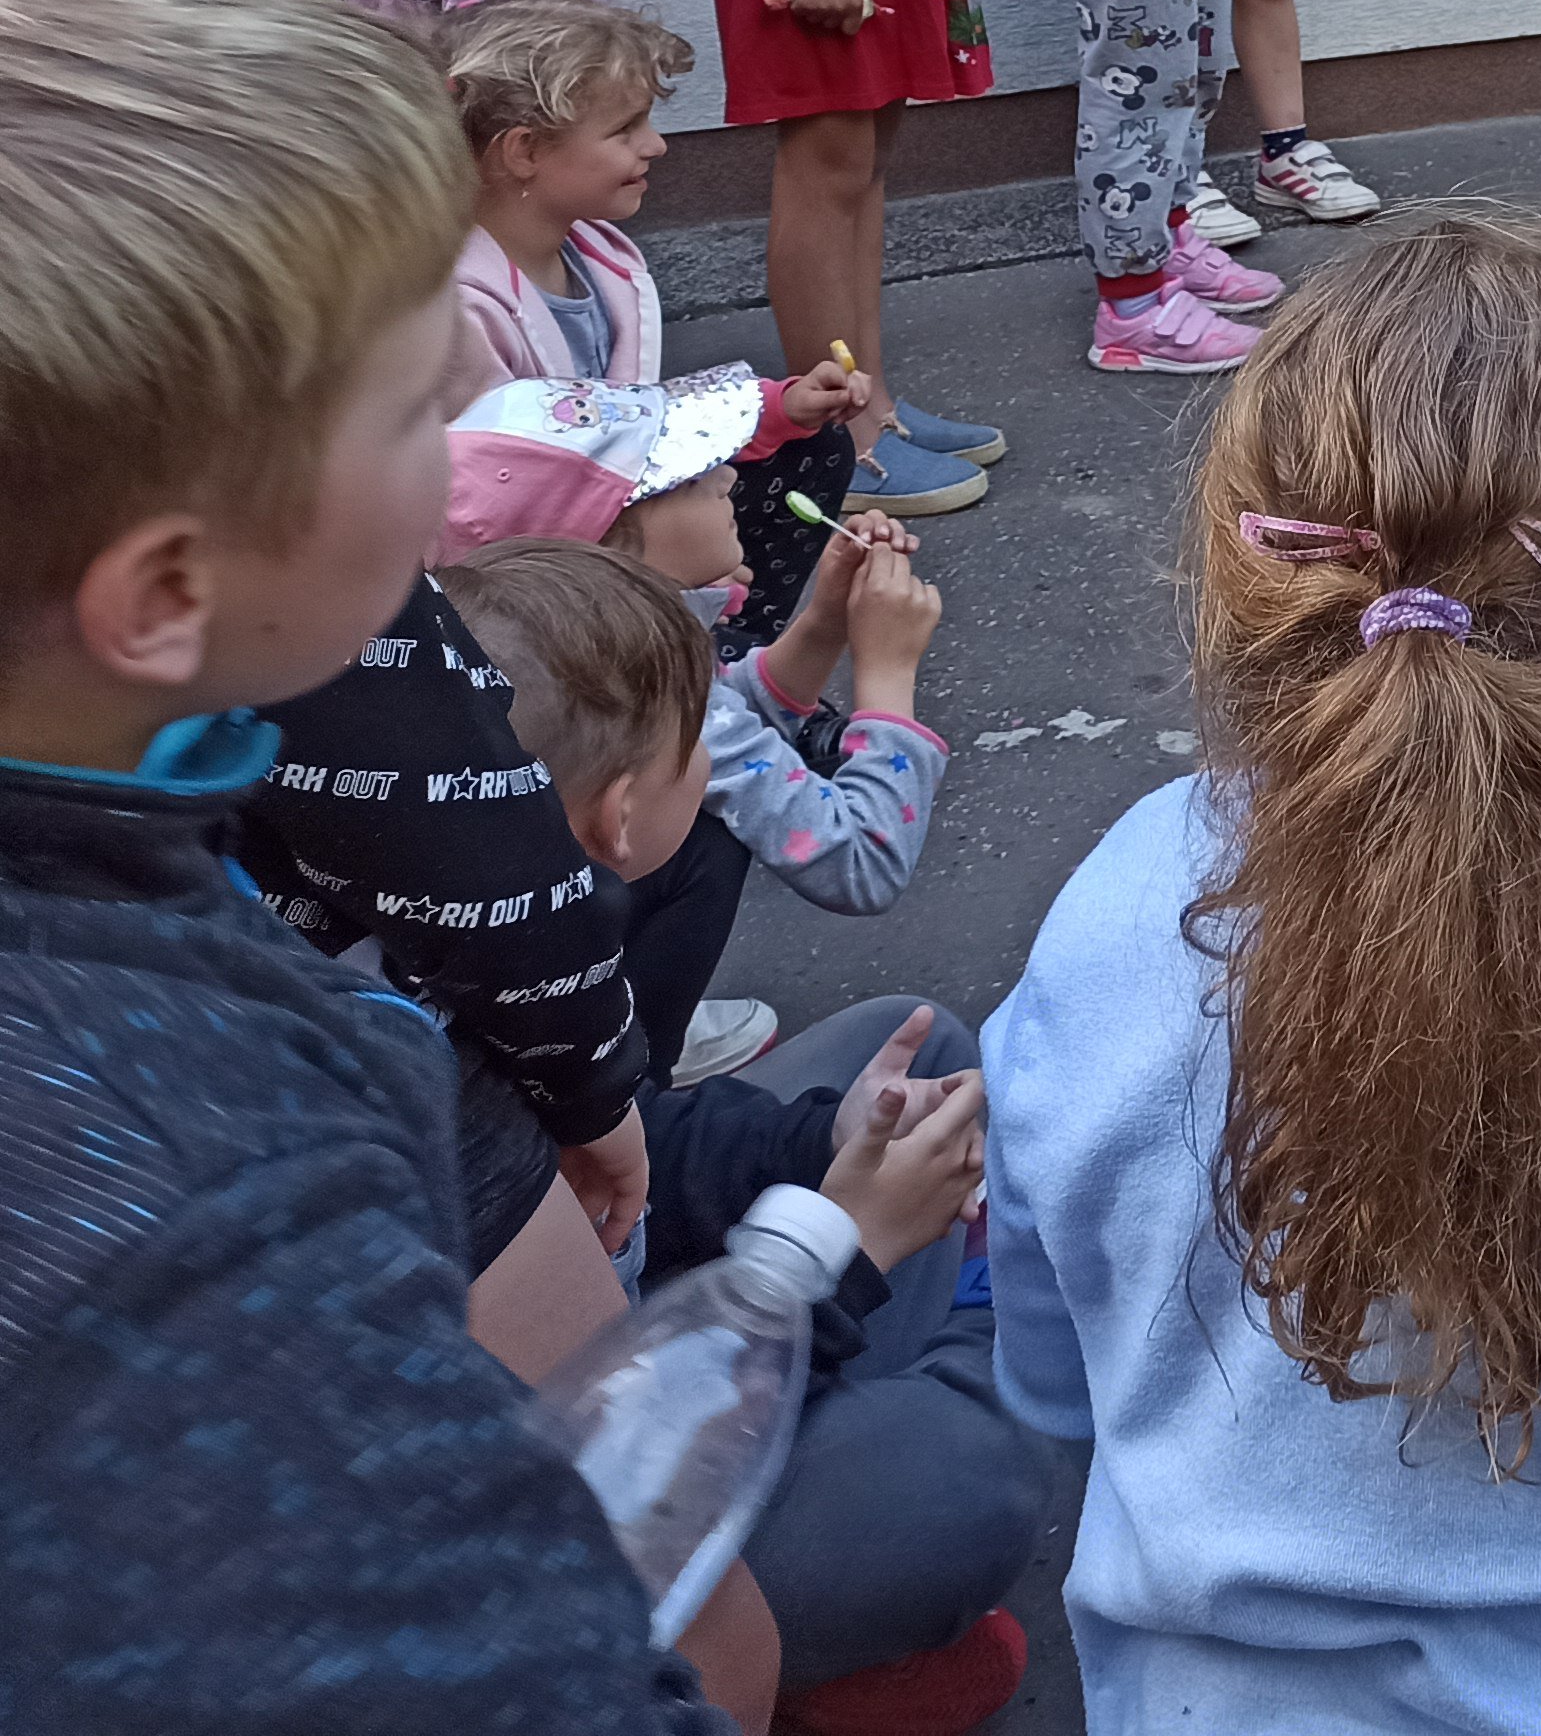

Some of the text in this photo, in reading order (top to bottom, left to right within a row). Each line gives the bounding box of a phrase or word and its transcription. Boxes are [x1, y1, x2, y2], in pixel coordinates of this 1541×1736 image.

[360, 637, 418, 669] OUT
[332, 768, 400, 801] OUT
[487, 890, 535, 929] OUT
